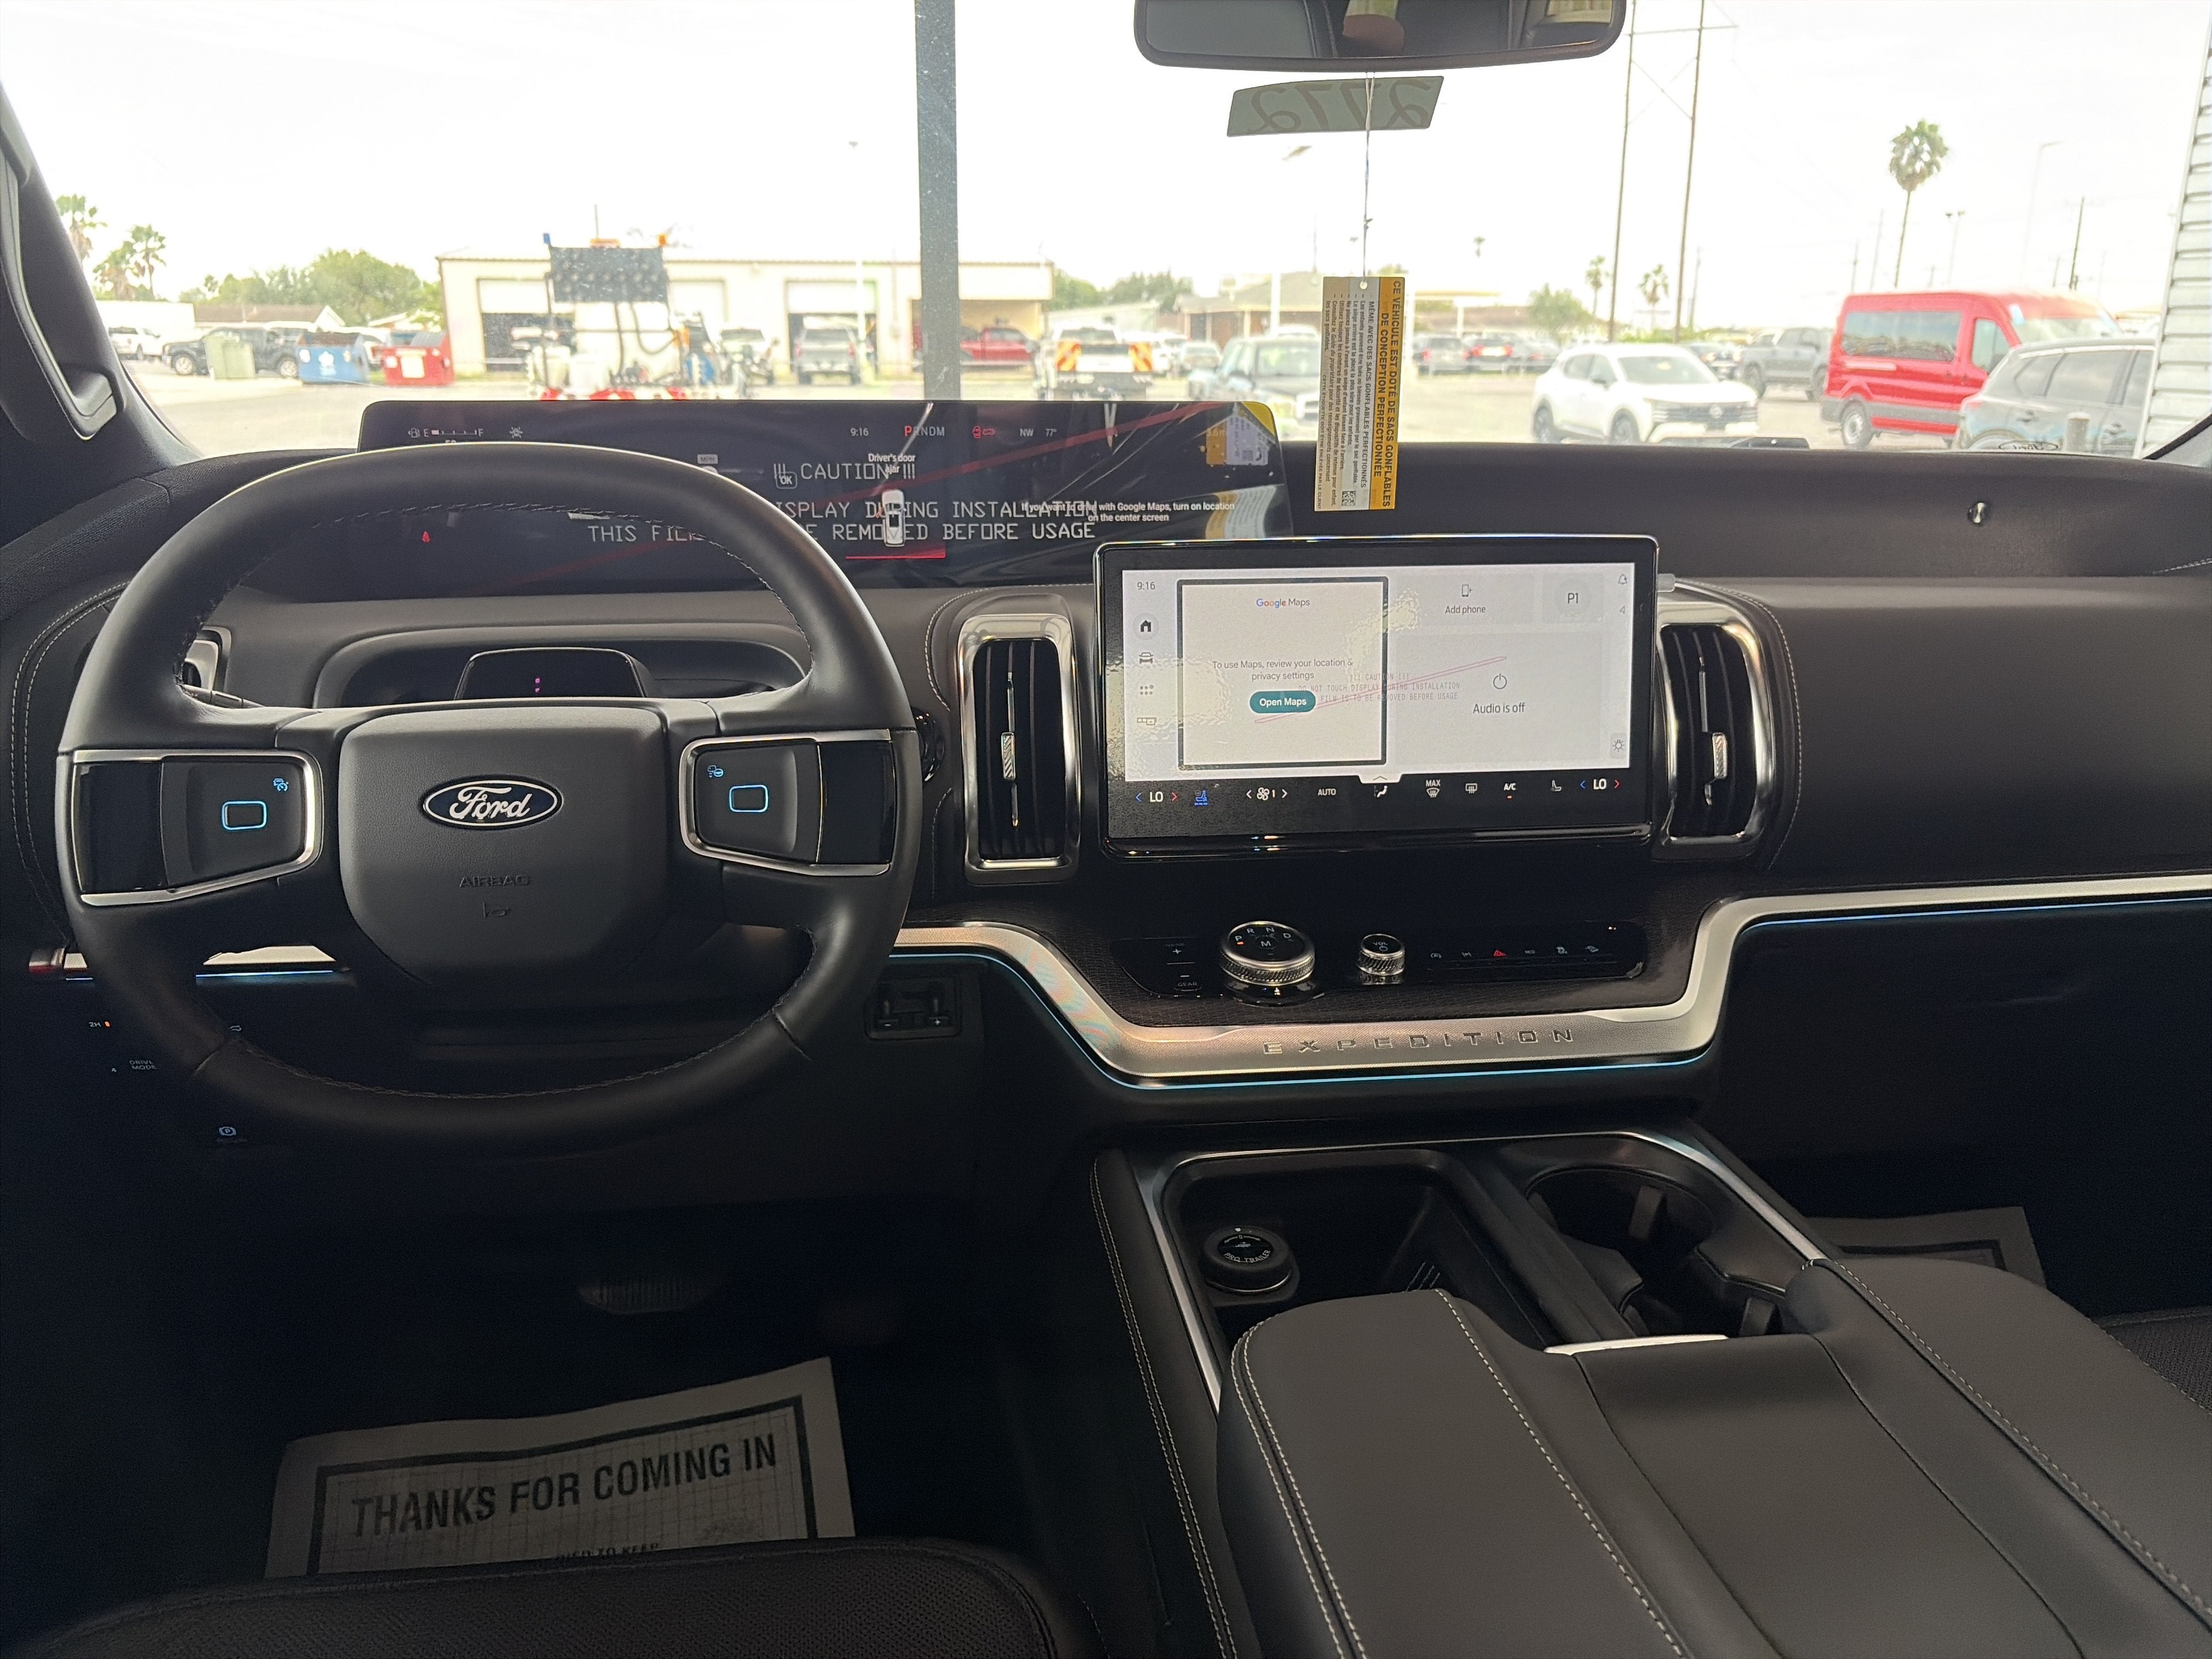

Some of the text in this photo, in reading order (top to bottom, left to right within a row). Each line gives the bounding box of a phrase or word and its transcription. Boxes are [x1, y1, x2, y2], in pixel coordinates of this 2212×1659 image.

[1393, 281, 1400, 294] CE
[1390, 297, 1401, 346] VÉHICULE
[1390, 349, 1398, 368] EST
[1388, 371, 1397, 397] DOTÉ
[1374, 313, 1388, 477] DE CONCEPTION PERFECTIONNÉE
[1387, 400, 1395, 414] DE
[850, 428, 869, 436] 9:16
[1020, 428, 1033, 437] NW
[1046, 428, 1057, 437] 77°
[868, 454, 916, 462] Driver's door
[1360, 431, 1368, 488] PERFECTIONNÉS
[800, 462, 889, 479] CAUTION
[885, 464, 900, 474] ajar
[780, 476, 792, 485] OK
[1383, 445, 1392, 507] GONFLABLES
[953, 500, 1097, 518] INSTALLATION
[1098, 502, 1116, 511] with
[1117, 502, 1146, 512] Google
[1147, 502, 1172, 512] Maps,
[1173, 503, 1189, 511] turn
[1203, 501, 1235, 510] location
[588, 525, 637, 542] THIS
[943, 523, 1019, 540] BEFORE
[1032, 522, 1096, 539] USAGE
[1137, 582, 1155, 590] 9:16
[1256, 597, 1310, 609] Google Maps
[1567, 592, 1579, 603] P1
[1444, 605, 1486, 616] Add phone
[1240, 661, 1264, 669] Maps,
[1252, 672, 1314, 681] privacy settings
[1412, 682, 1460, 690] INSTALLATION
[1259, 697, 1307, 708] Open Maps
[1472, 702, 1526, 714] Audio is off
[1503, 783, 1516, 791] A/C
[1594, 778, 1606, 790] LO
[1149, 791, 1164, 803] LO
[1272, 789, 1276, 798] 1
[450, 786, 532, 820] Ford
[1263, 1028, 1574, 1056] EXPEDITION
[1244, 1250, 1271, 1263] TRAILER
[352, 1434, 776, 1537] THANKS FOR COMING IN
